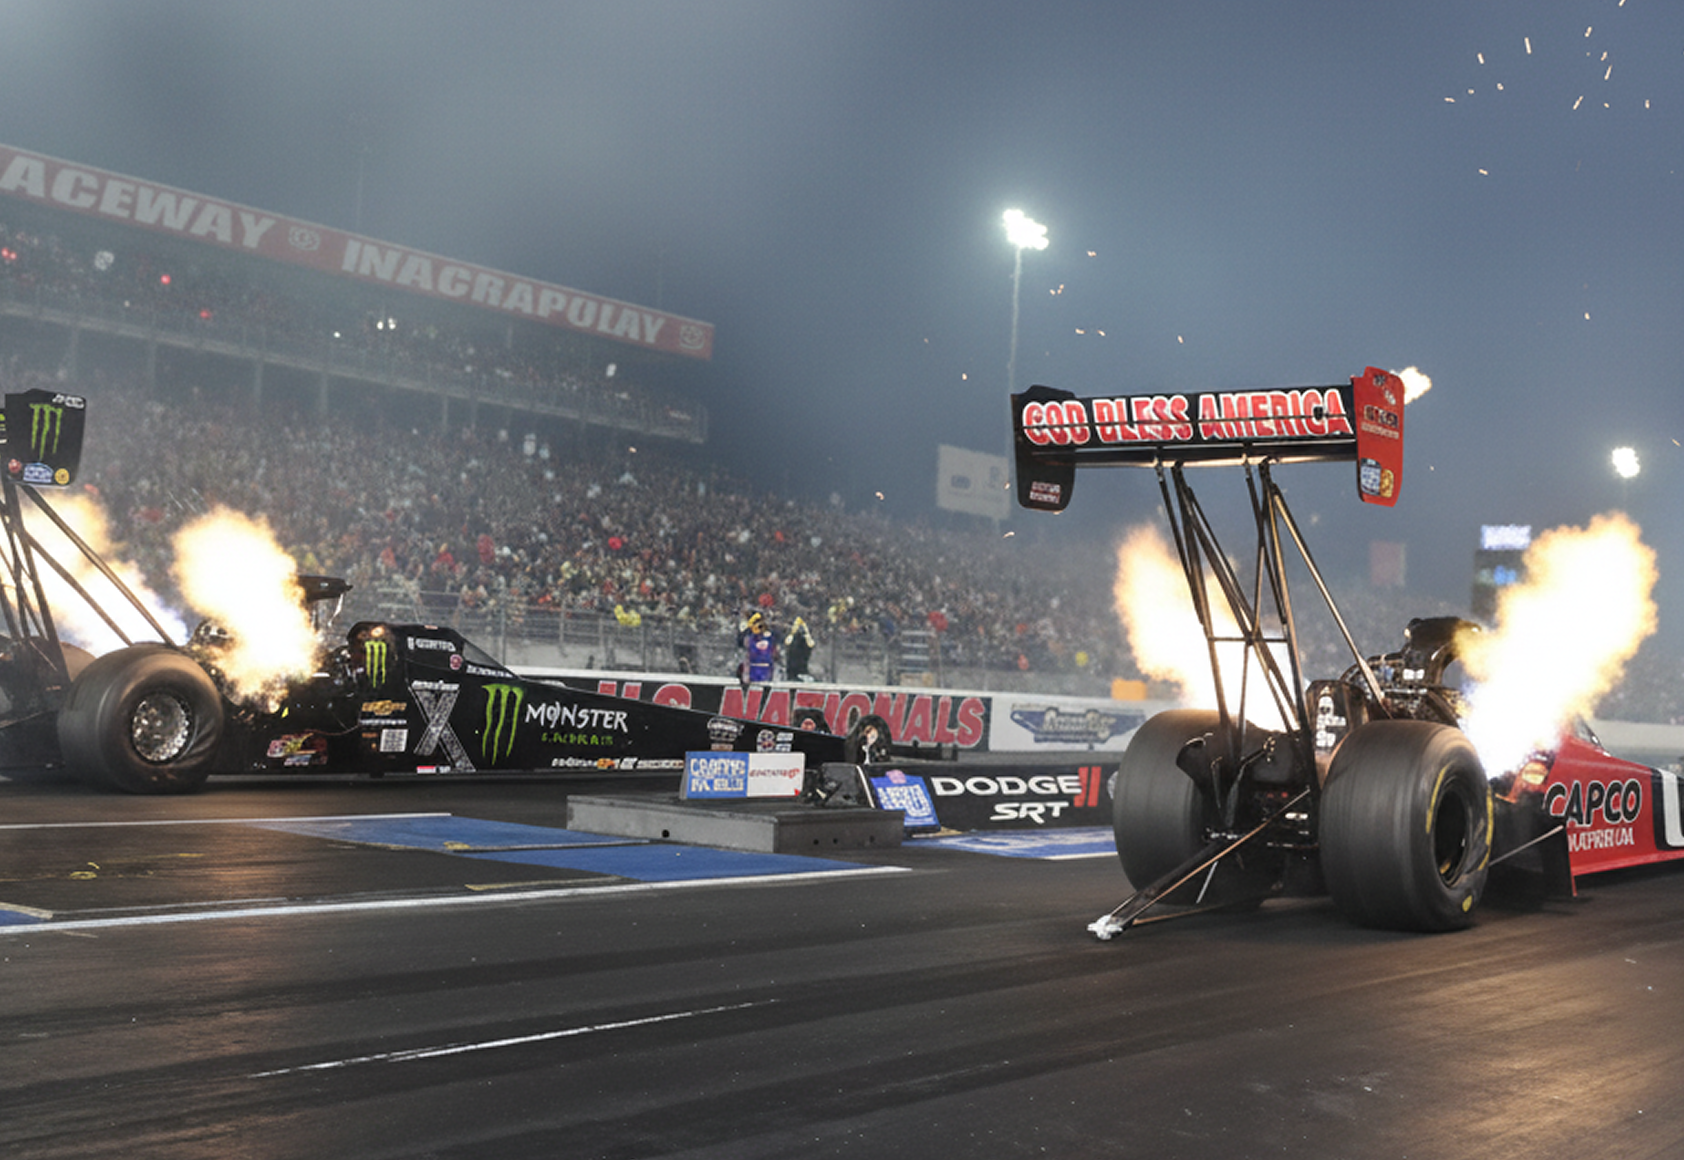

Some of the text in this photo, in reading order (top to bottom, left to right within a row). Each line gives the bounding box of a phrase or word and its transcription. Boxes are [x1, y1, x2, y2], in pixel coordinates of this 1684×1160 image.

[524, 701, 629, 734] MONSTER
[931, 775, 1082, 796] DODGE
[990, 801, 1069, 825] SRT
[1542, 778, 1643, 827] CAPCO
